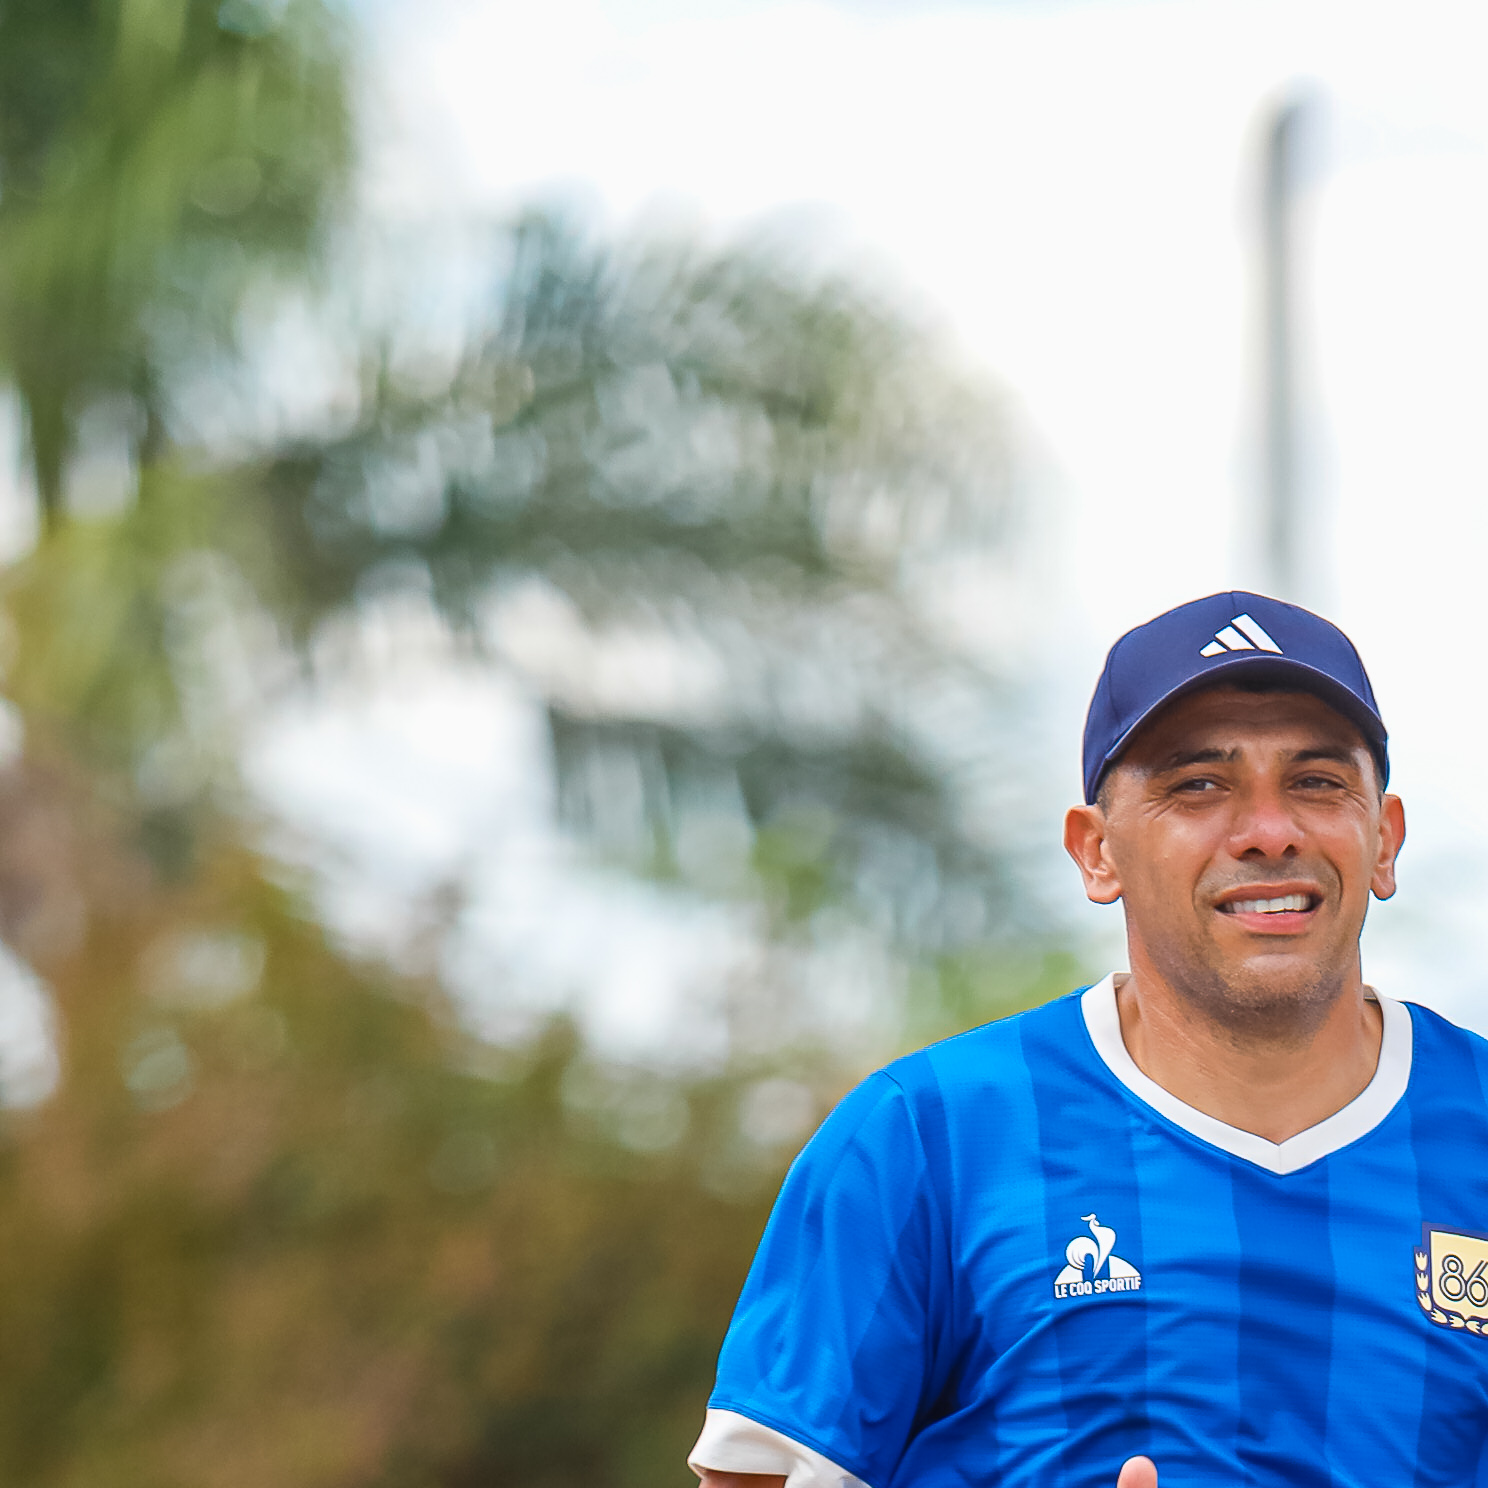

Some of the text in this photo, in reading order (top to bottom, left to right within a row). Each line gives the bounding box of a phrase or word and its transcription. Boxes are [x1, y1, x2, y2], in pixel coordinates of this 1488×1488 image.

[1054, 1276, 1142, 1299] LE COQ SPORTIF
